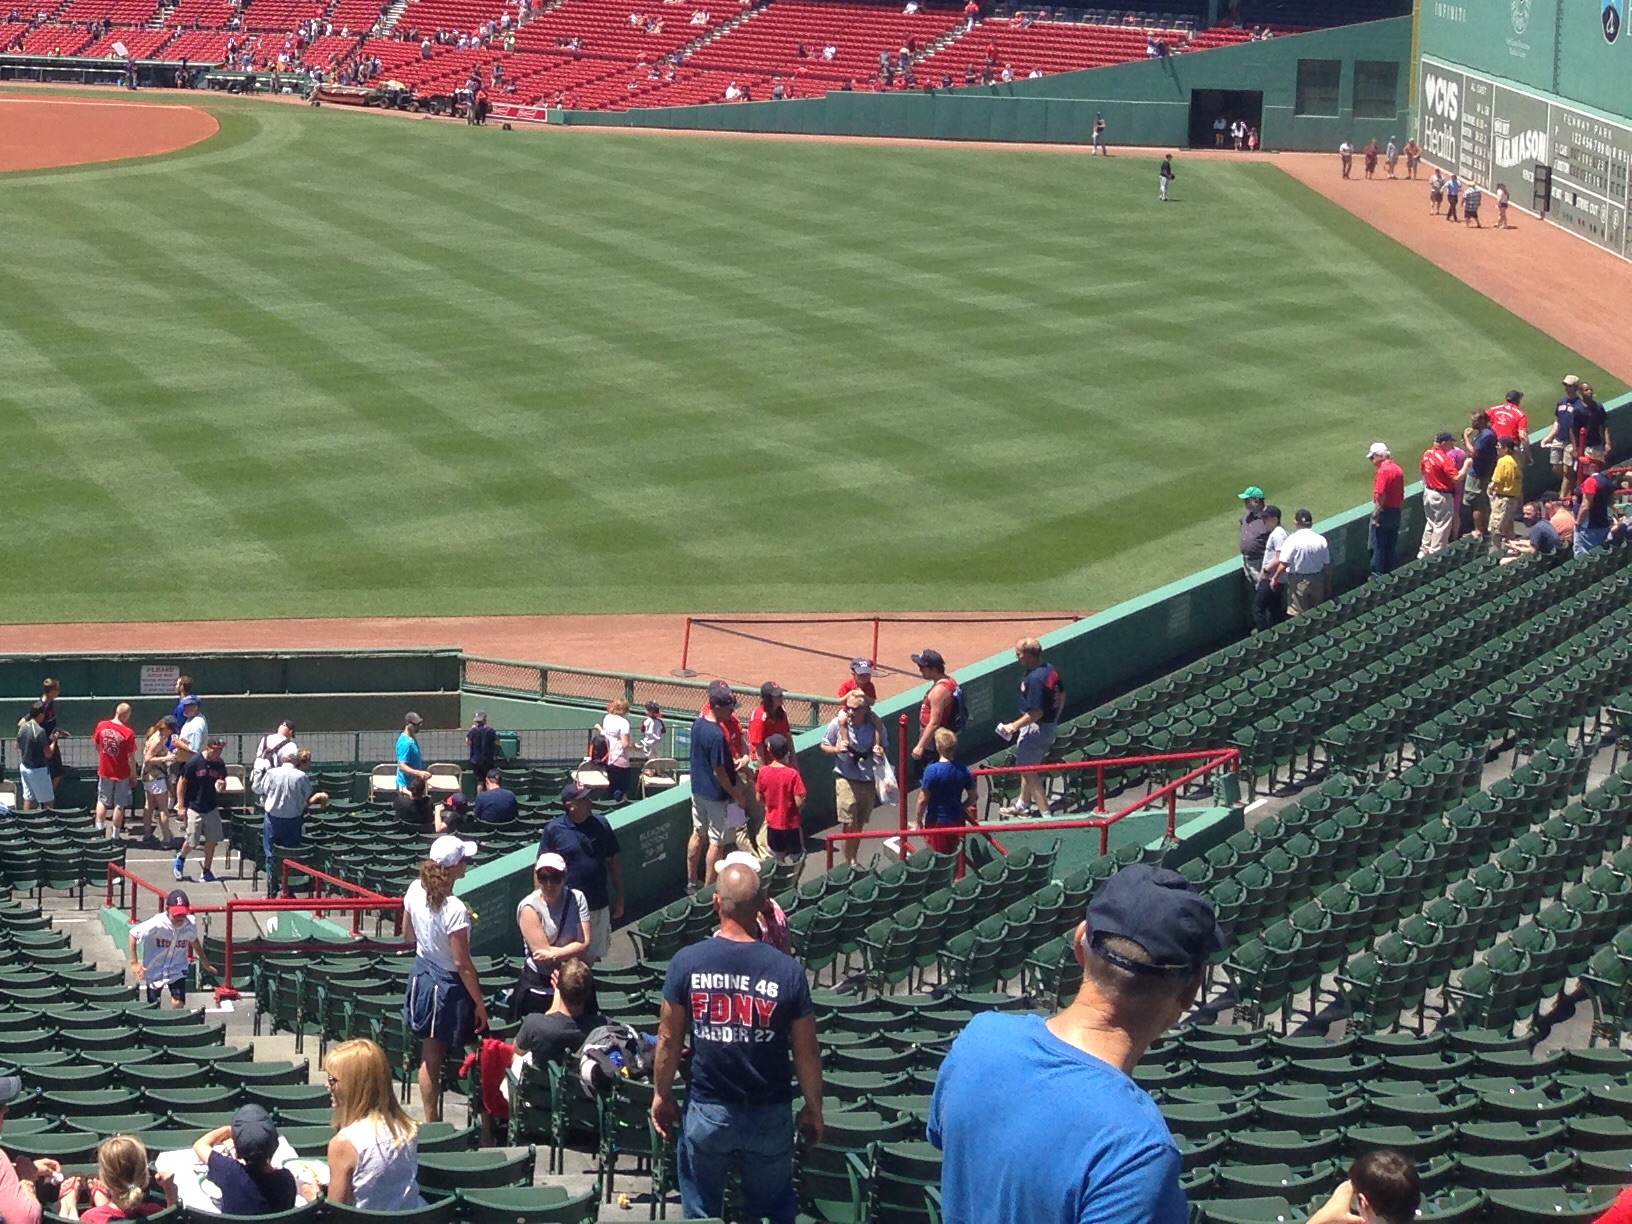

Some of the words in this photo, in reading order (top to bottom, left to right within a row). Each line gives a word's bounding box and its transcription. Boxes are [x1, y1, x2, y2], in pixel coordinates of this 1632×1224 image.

[1435, 77, 1459, 121] CVS
[1424, 115, 1456, 164] Health
[1563, 113, 1590, 131] FENWAY
[1593, 124, 1612, 140] PARK
[691, 973, 750, 991] ENGINE
[754, 979, 779, 998] 46
[691, 992, 778, 1028] FDNY
[692, 1022, 750, 1043] LADDER
[754, 1029, 775, 1043] 27
